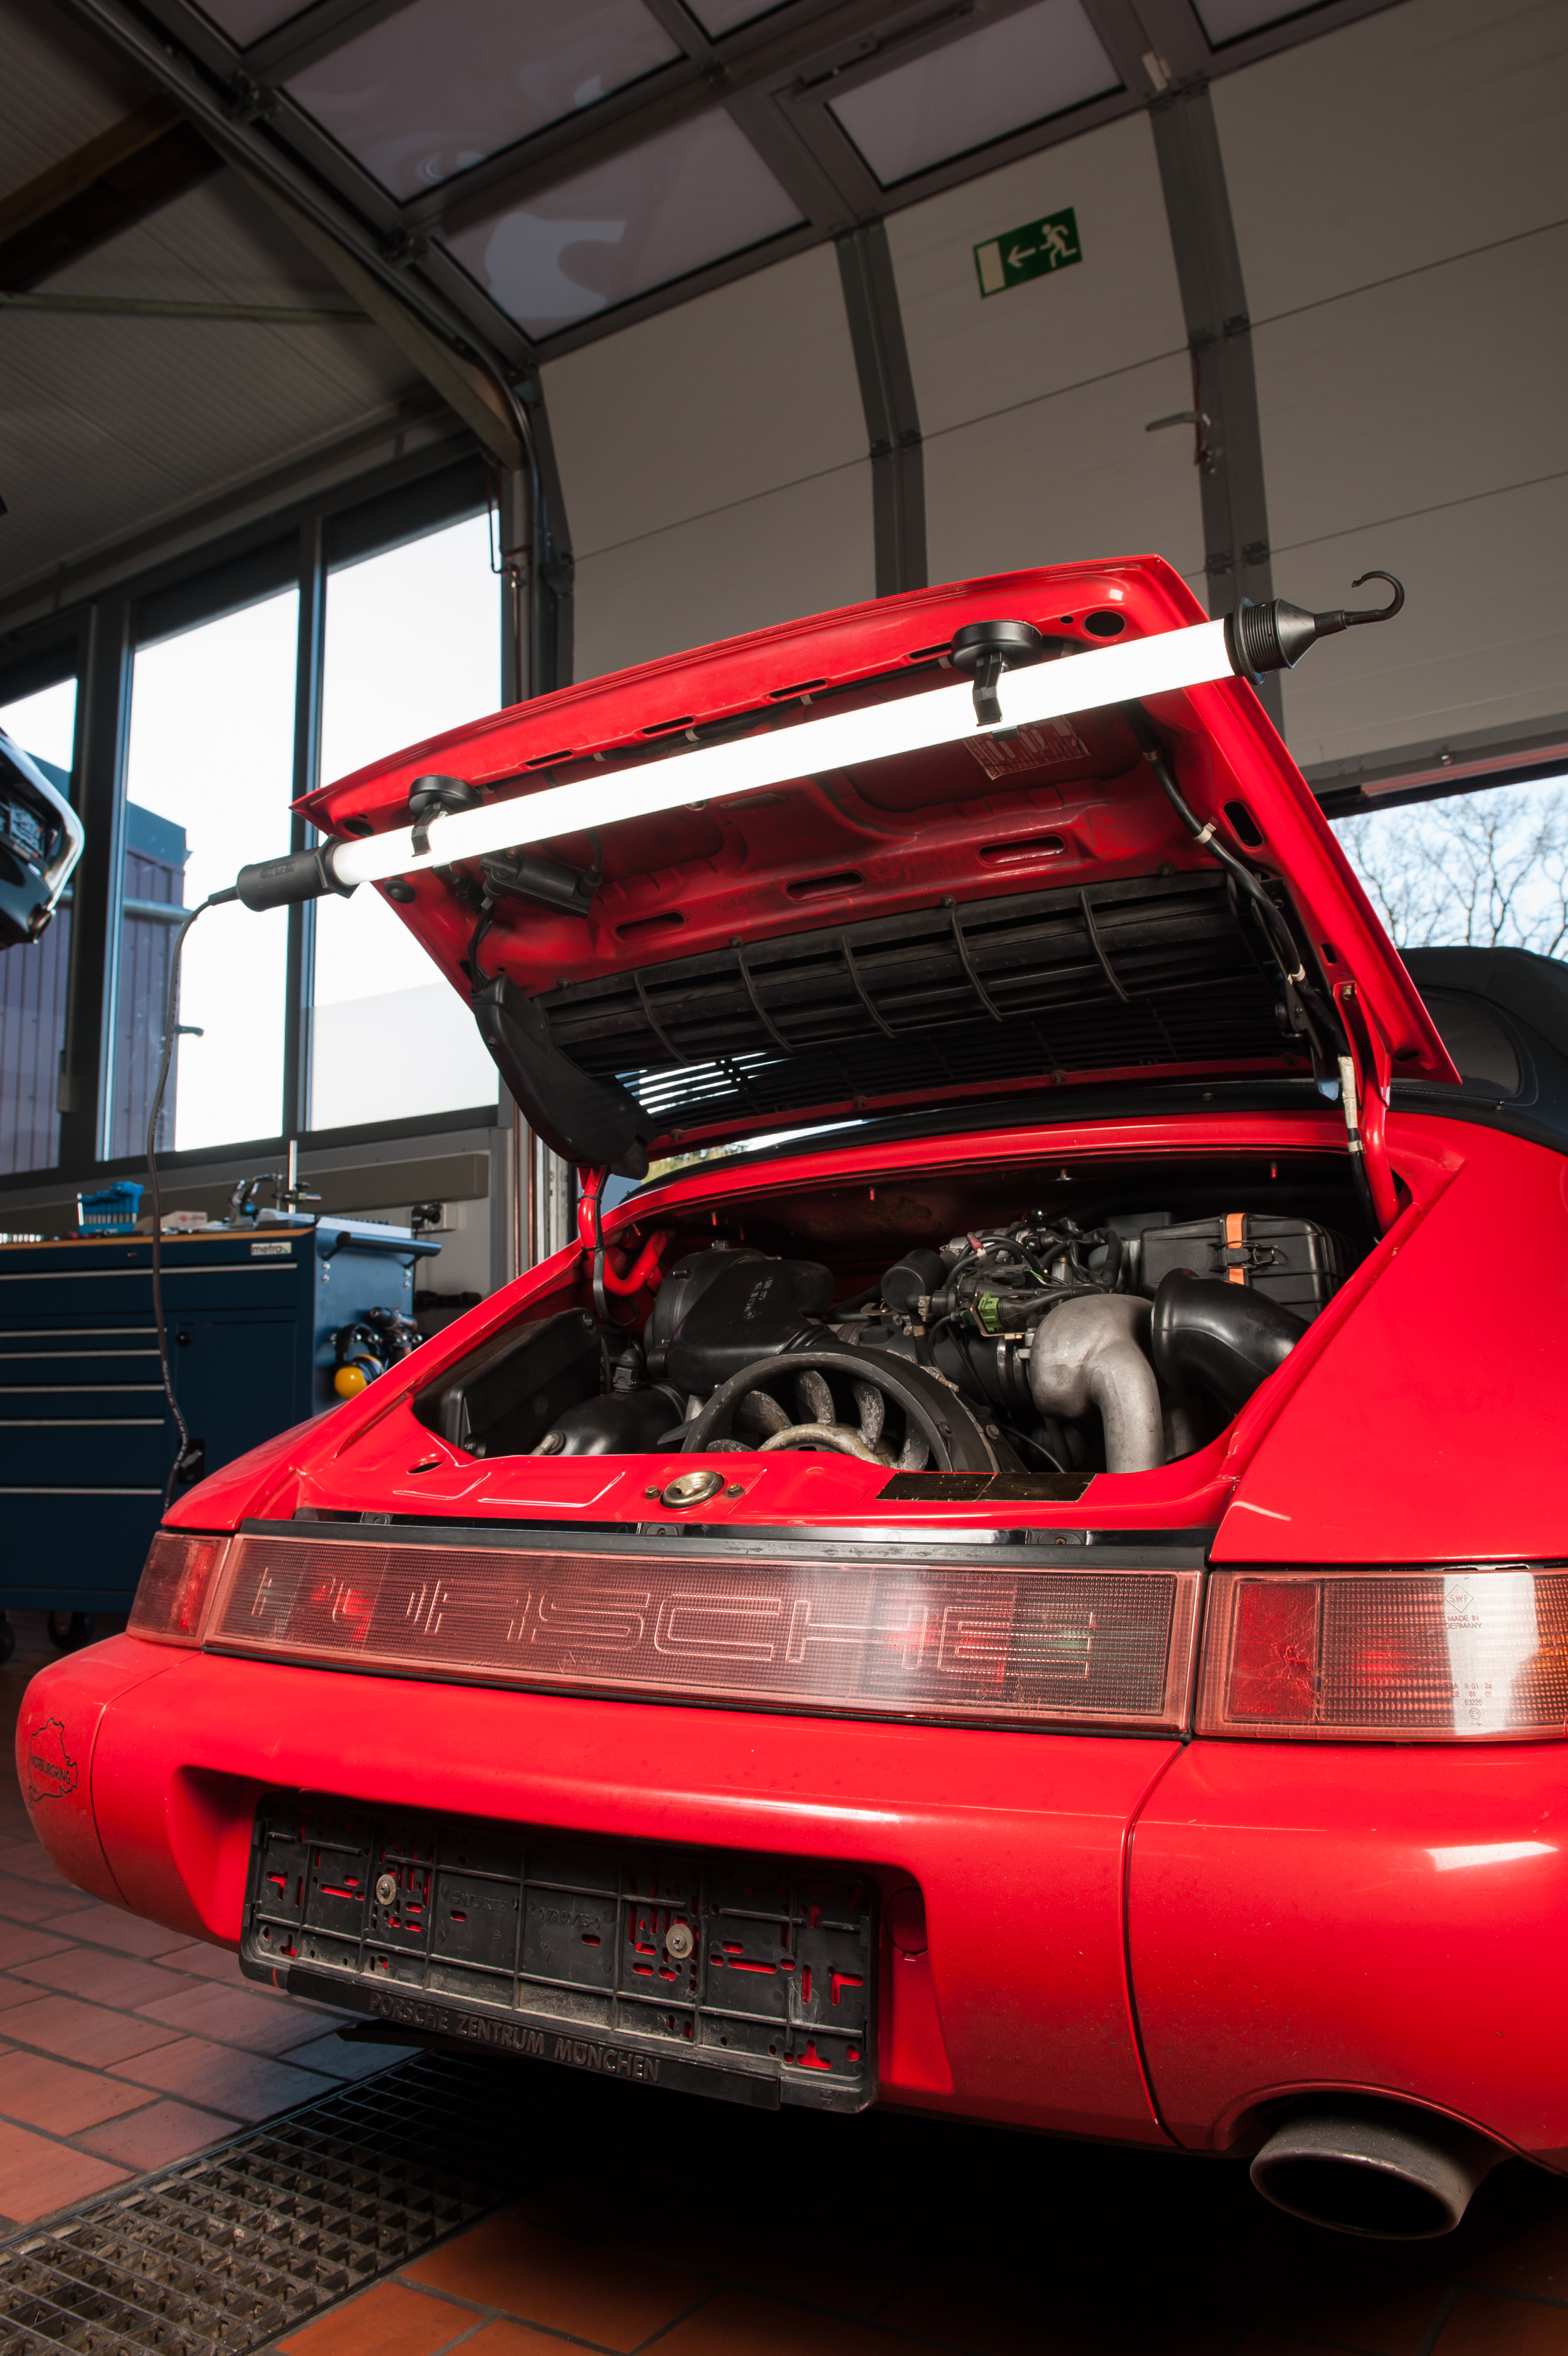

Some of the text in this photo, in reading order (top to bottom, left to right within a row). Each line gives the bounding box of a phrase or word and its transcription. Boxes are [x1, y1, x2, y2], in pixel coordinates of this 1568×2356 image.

[251, 1567, 1095, 1678] PORSCHE
[1449, 1594, 1468, 1603] SWF
[369, 1992, 660, 2082] PORSCHE ZENTRUM MÜNCHEN
